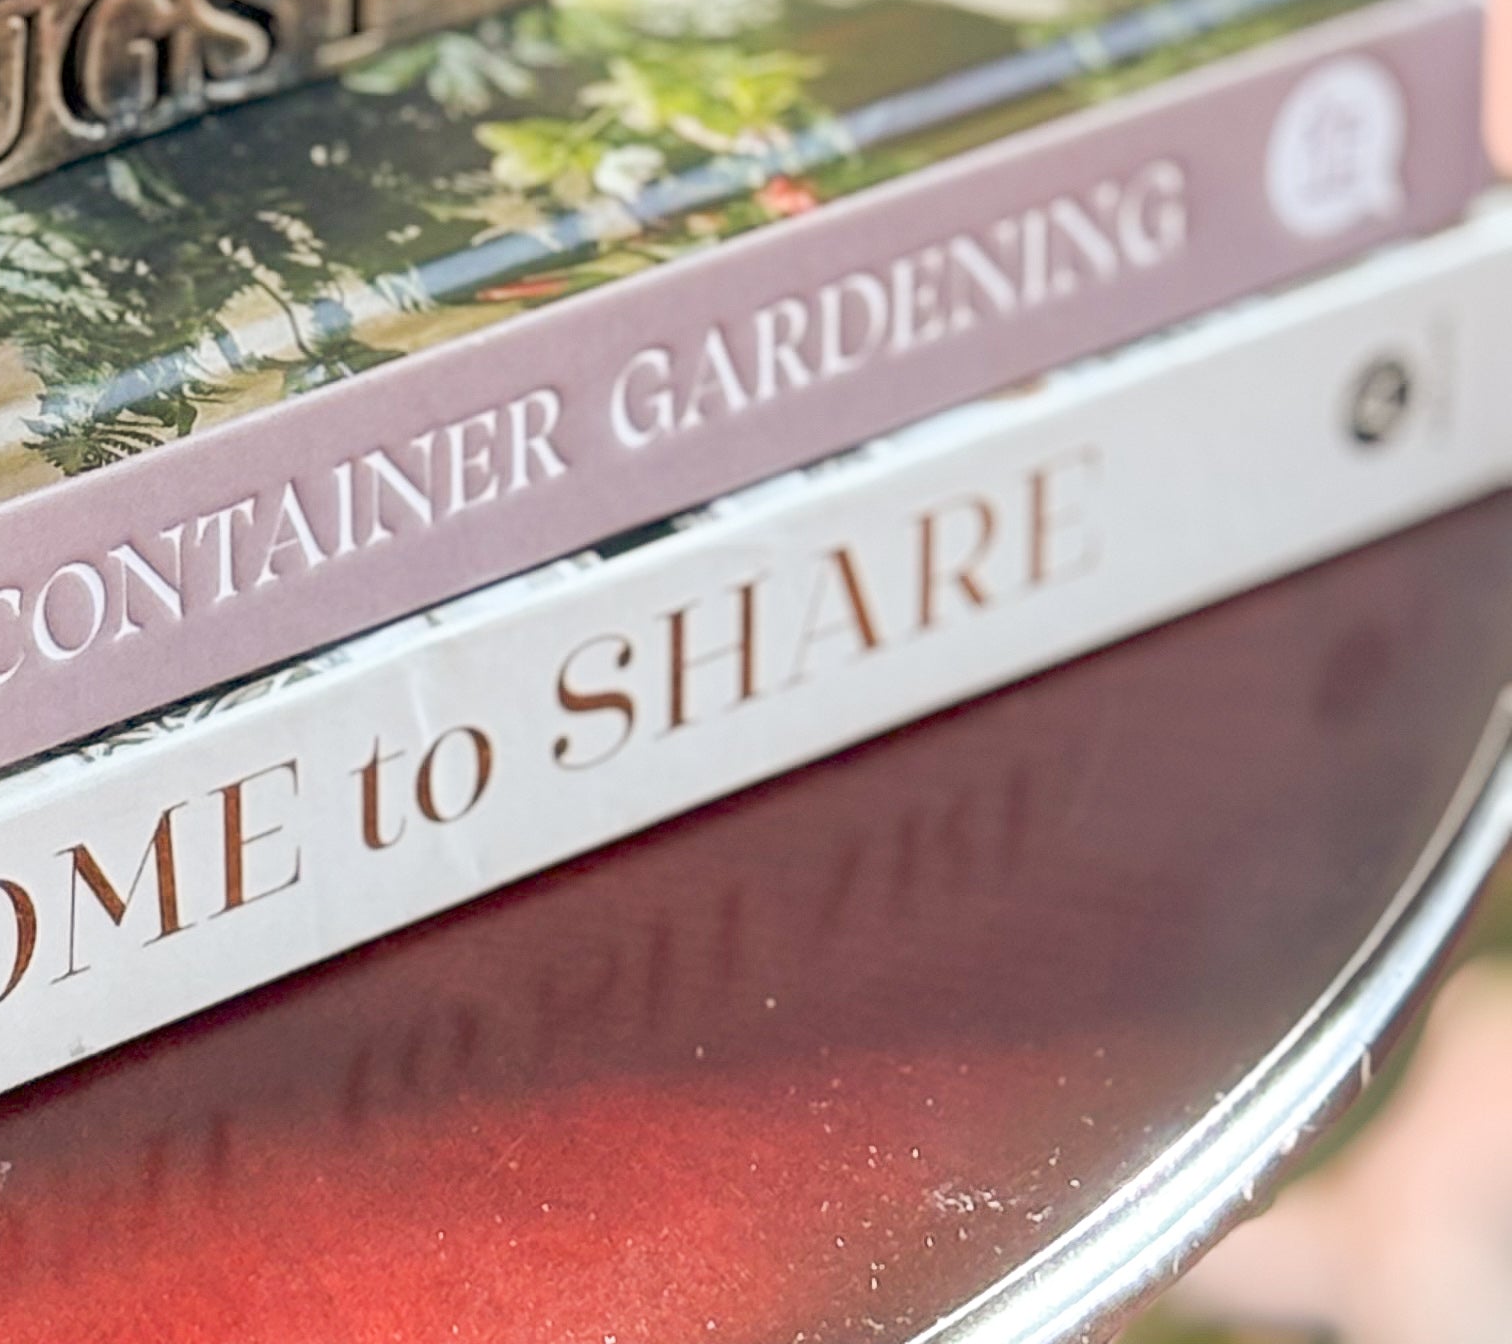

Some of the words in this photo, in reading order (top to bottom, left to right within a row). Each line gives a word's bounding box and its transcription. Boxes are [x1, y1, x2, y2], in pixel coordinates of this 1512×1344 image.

[609, 158, 1186, 450] GARDENING
[348, 722, 494, 852] to
[550, 444, 1104, 772] SHARE
